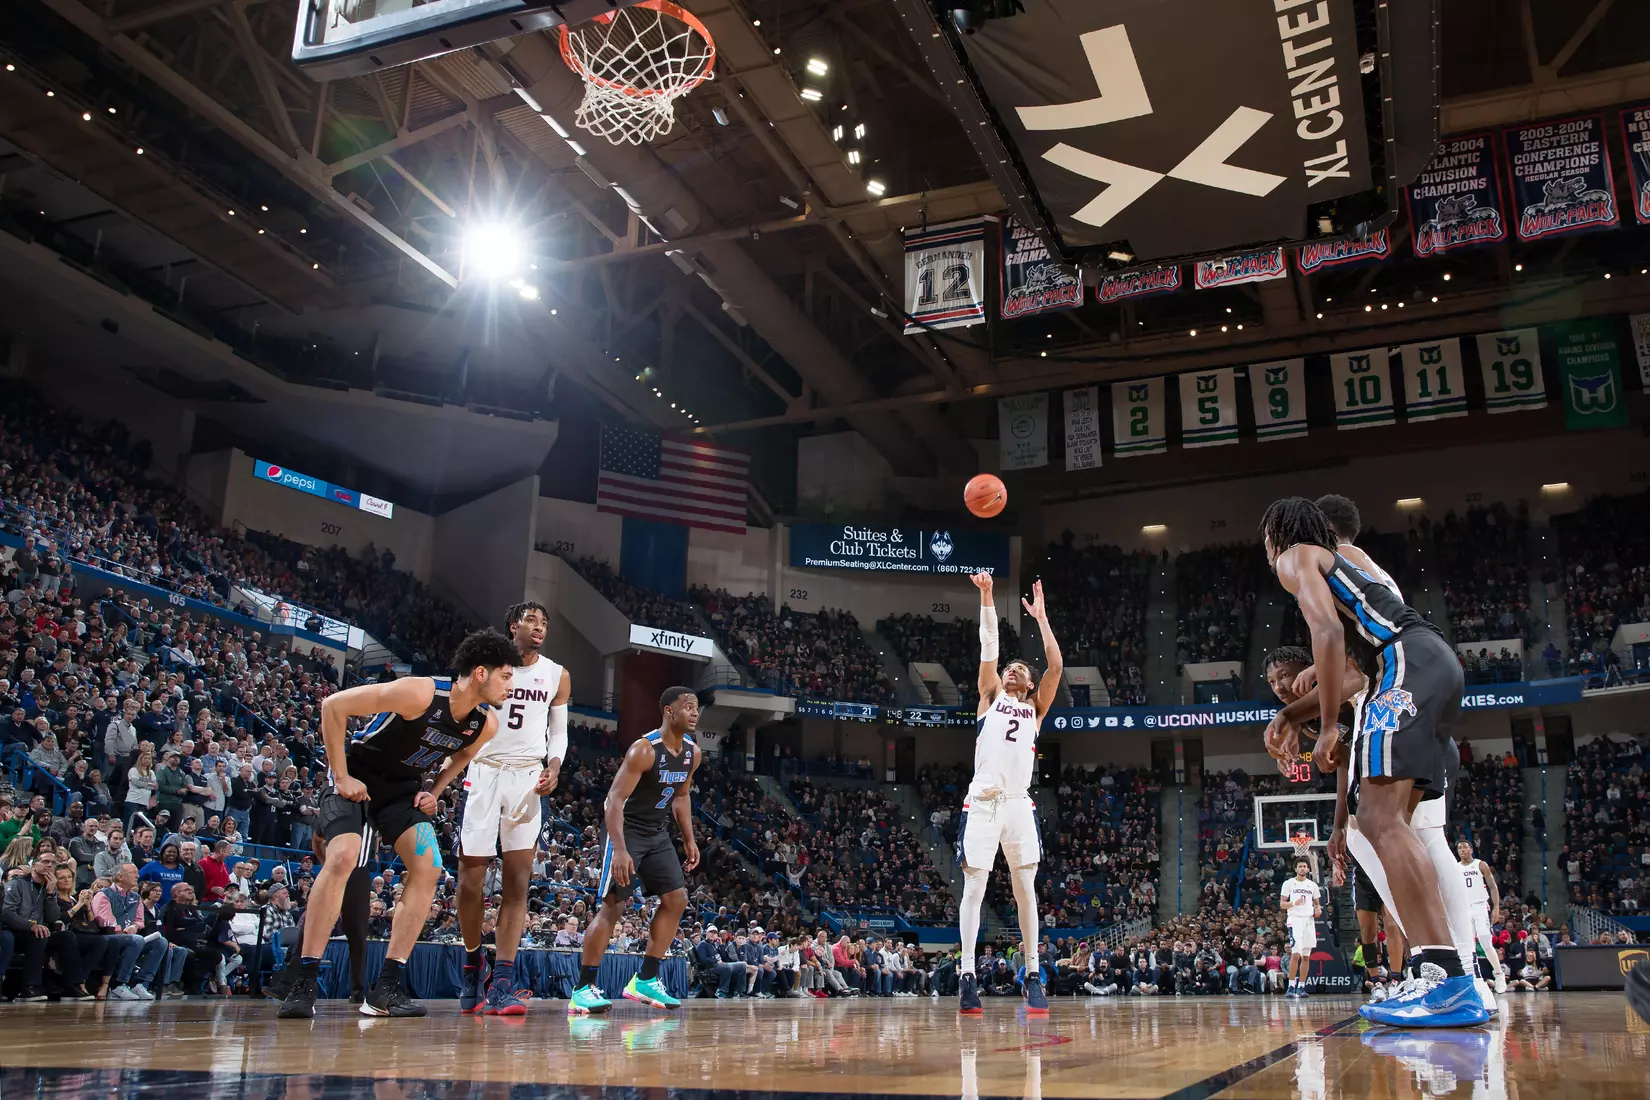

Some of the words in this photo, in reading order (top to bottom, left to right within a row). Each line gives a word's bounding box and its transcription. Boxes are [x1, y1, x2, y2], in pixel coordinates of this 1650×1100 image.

[1520, 120, 1593, 140] 2003-2004
[1438, 138, 1484, 155] 3-2004
[1523, 131, 1590, 151] EASTERN
[1428, 152, 1481, 170] LANTIC
[1514, 142, 1599, 164] CONFERENCE
[1304, 139, 1350, 188] XL
[1515, 154, 1599, 176] CHAMPIONS
[1421, 166, 1477, 184] DIVISION
[1525, 173, 1558, 182] REGULAR
[1561, 167, 1590, 176] SEASON
[1414, 178, 1487, 199] CHAMPIONS
[1523, 212, 1560, 234] WOLF
[1567, 201, 1608, 222] PACK
[1420, 229, 1452, 250] WOLF
[1458, 218, 1498, 239] PACK
[1016, 237, 1044, 251] SEA
[1005, 249, 1050, 265] CHAMP
[1241, 253, 1278, 273] PACK
[1305, 243, 1340, 265] WOLF
[919, 264, 970, 305] 12
[1103, 279, 1137, 298] WOLF
[1138, 269, 1176, 290] PACK
[1007, 290, 1042, 313] WOLF
[1043, 284, 1078, 304] PACK
[1567, 353, 1609, 365] CHAMPIONS
[1417, 366, 1451, 398] 11
[1492, 359, 1535, 393] 19
[1345, 375, 1380, 407] 10
[1200, 396, 1220, 424] 5
[1268, 388, 1289, 419] 9
[1130, 406, 1148, 436] 2
[283, 472, 316, 490] pepsi
[321, 522, 341, 536] 207
[843, 526, 887, 542] Suites
[891, 529, 903, 542] &
[556, 541, 575, 552] 231
[830, 540, 863, 555] Club
[866, 542, 916, 558] Tickets
[805, 558, 929, 571] PremiumSeating@XLCenter.com
[937, 563, 957, 573] (860)
[168, 594, 186, 607] 105
[790, 589, 808, 600] 232
[932, 603, 950, 613] 233
[650, 631, 694, 651] xfinity
[508, 688, 548, 702] ONN
[1461, 694, 1523, 707] KIES.COM
[508, 704, 525, 729] 5
[862, 707, 872, 715] 21
[887, 710, 902, 718] 1:48
[910, 711, 921, 719] 22
[1144, 713, 1214, 728] @UCONN
[1216, 709, 1277, 723] HUSKIES
[421, 727, 463, 749] Tigers
[702, 731, 716, 739] 107
[1005, 720, 1019, 742] 2
[401, 746, 444, 768] 14
[1297, 752, 1312, 762] :48
[659, 770, 688, 784] Tigers
[655, 787, 674, 809] 2
[1466, 878, 1472, 887] 0
[1295, 976, 1351, 986] TAVELERS
